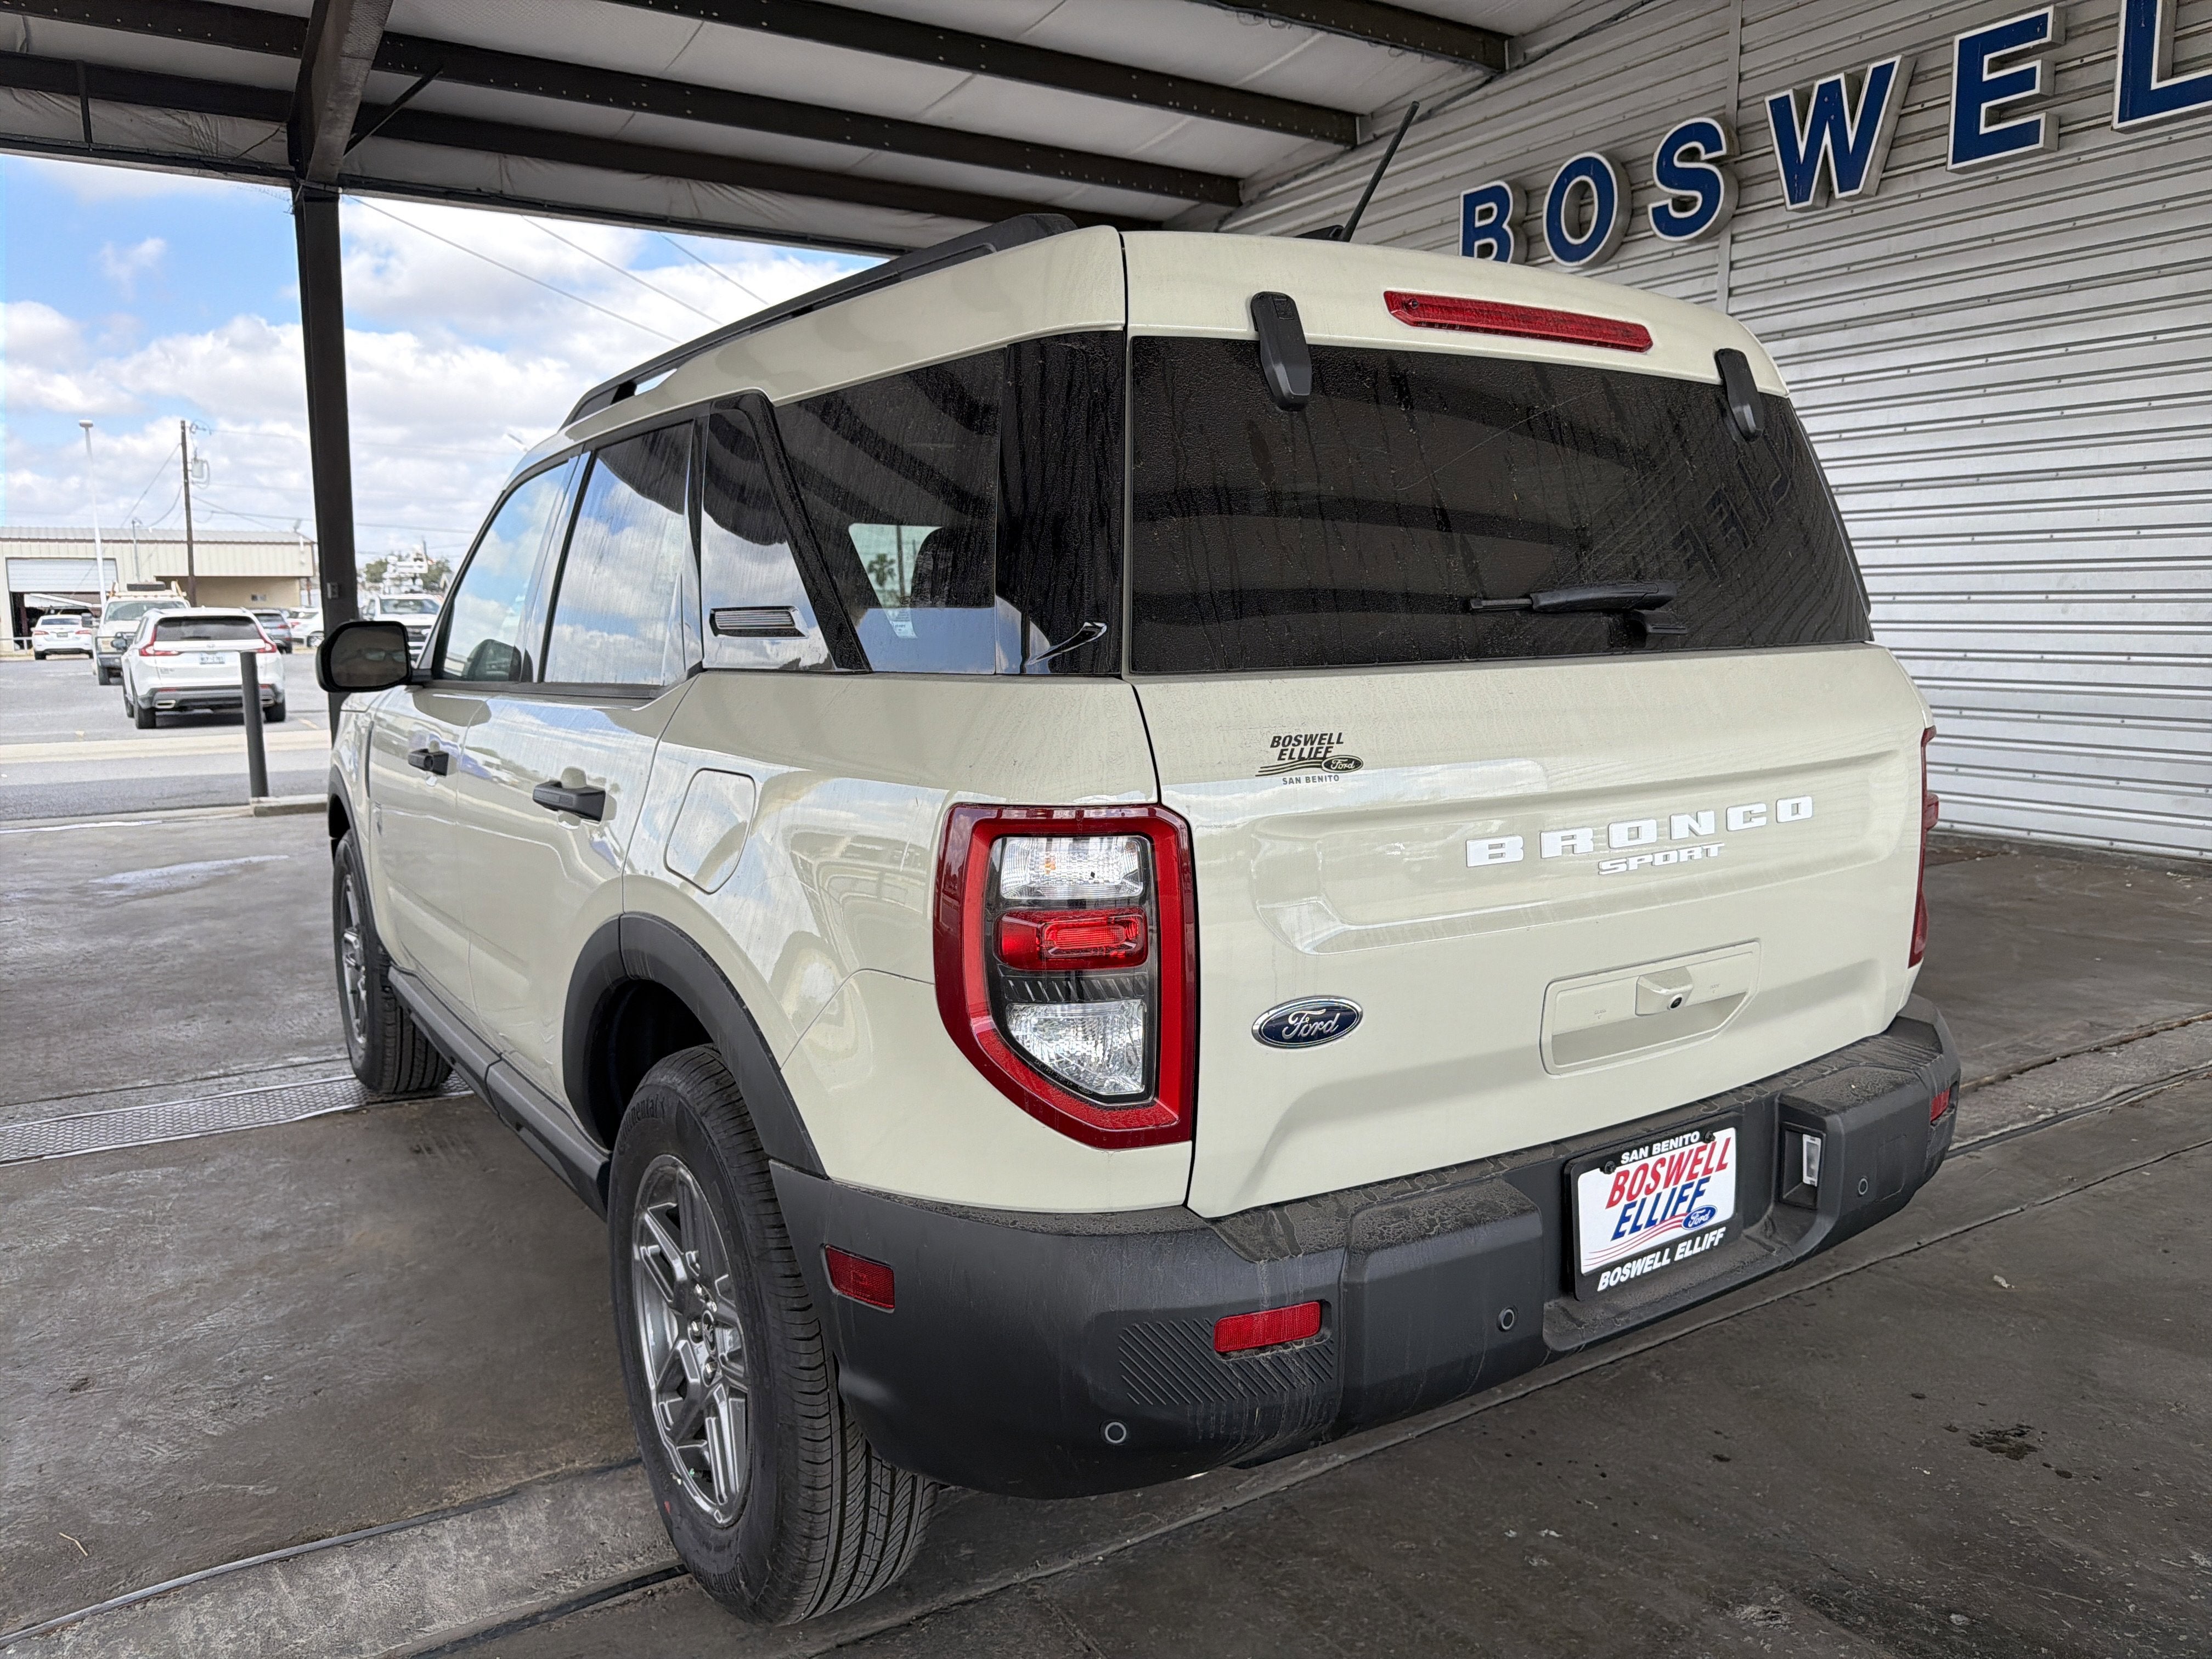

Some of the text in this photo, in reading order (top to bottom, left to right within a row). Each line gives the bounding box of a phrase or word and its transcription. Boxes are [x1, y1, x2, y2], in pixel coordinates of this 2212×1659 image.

[1459, 0, 2212, 268] BOSWEL
[1270, 732, 1344, 748] BOSWELL
[1277, 746, 1334, 761] ELLIFF
[1282, 774, 1340, 785] SAN BENITO
[1330, 759, 1355, 770] Ford
[1466, 795, 1813, 867] BRONCO
[1598, 843, 1725, 874] SPORT
[1282, 1008, 1341, 1040] Ford
[1621, 1131, 1700, 1164] SAN BENITO
[1605, 1137, 1731, 1209] BOSWELL
[1611, 1176, 1711, 1242] ELLIFF
[1688, 1211, 1710, 1228] Ford
[1597, 1227, 1726, 1292] BOSWELL ELLIFF
